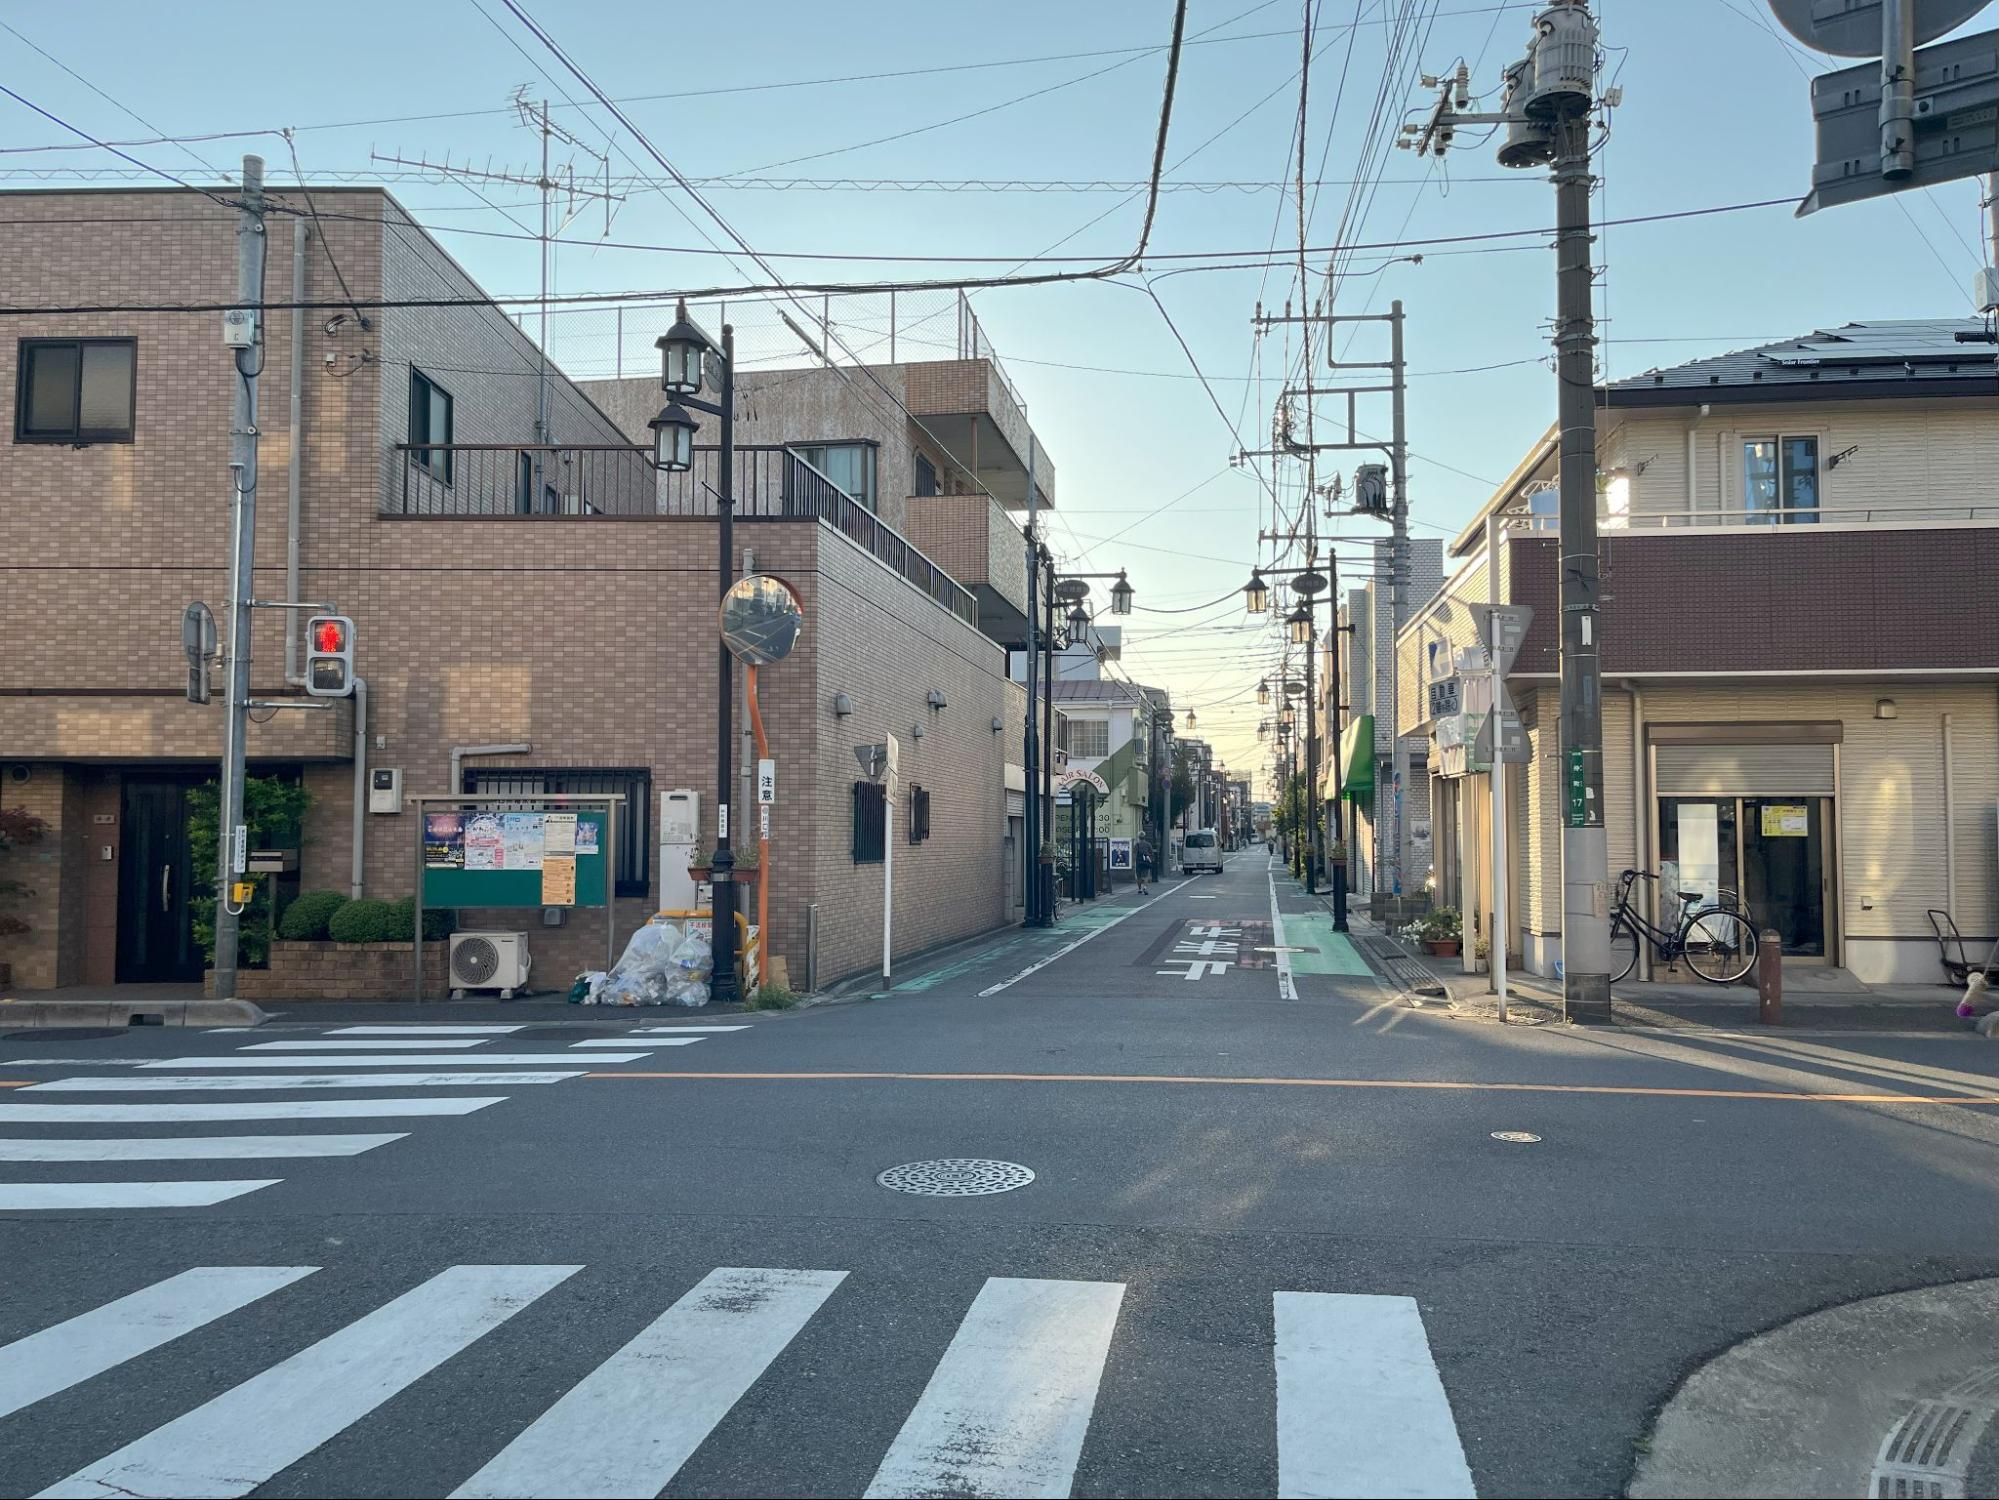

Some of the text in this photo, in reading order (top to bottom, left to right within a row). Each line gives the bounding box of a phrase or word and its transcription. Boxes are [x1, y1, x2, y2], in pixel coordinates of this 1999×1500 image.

[1431, 683, 1455, 700] 自動車
[761, 775, 773, 801] 注意
[1076, 769, 1104, 788] SALON
[1155, 926, 1243, 981] 止まれ
